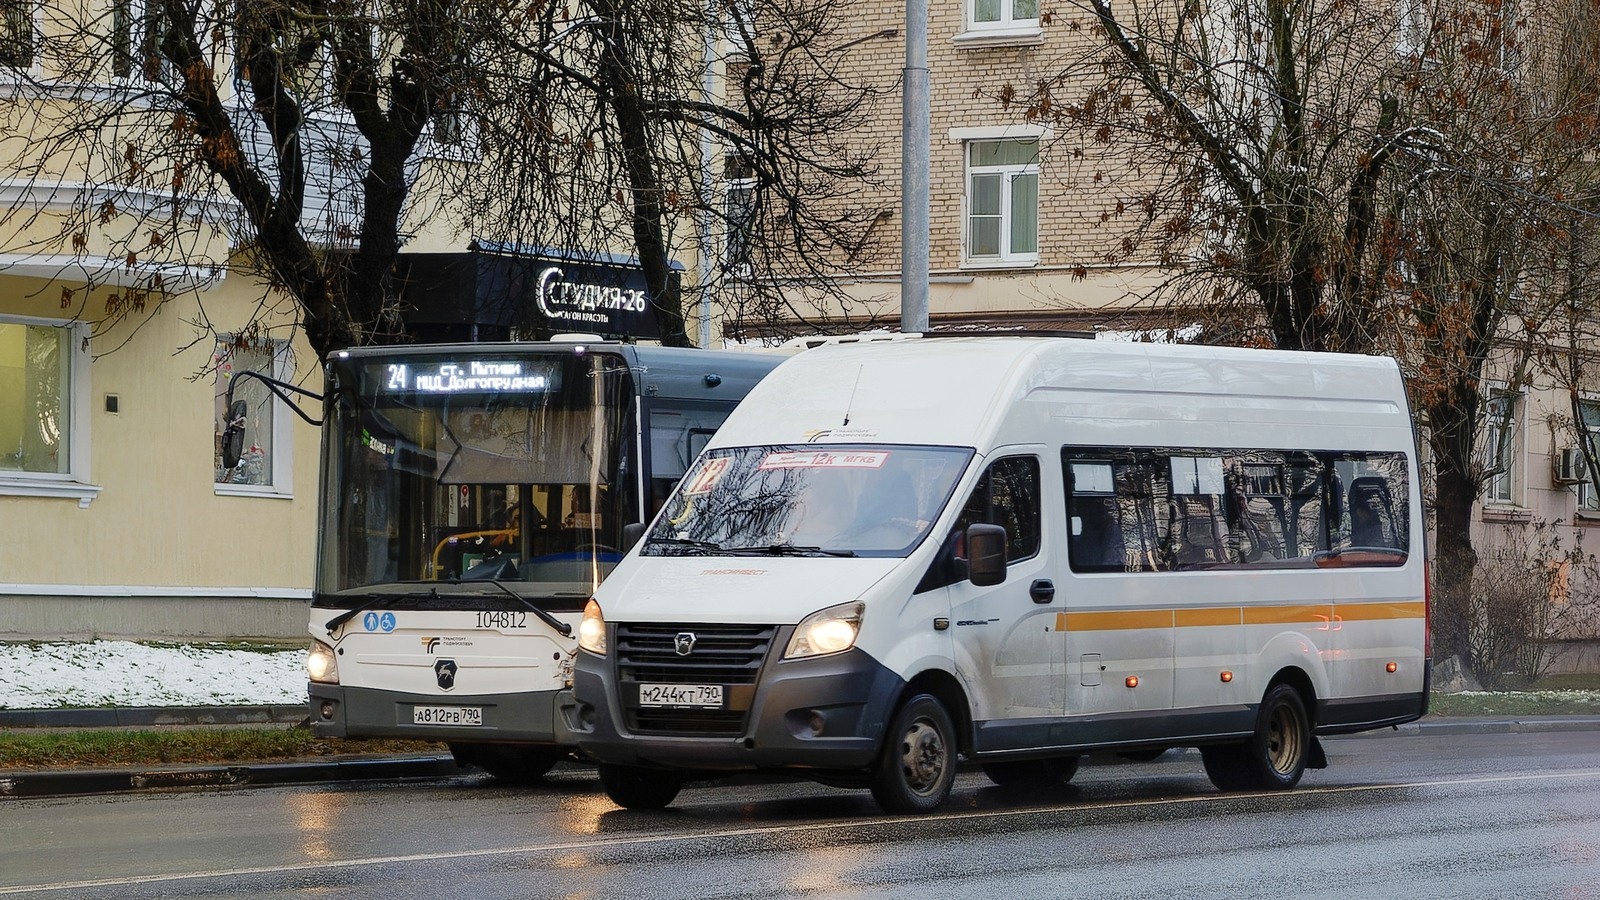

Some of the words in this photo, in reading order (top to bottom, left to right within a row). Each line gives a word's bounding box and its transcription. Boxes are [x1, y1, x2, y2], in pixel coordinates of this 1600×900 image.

[388, 364, 406, 389] 24
[475, 611, 527, 628] 104812
[417, 708, 460, 723] А812РВ
